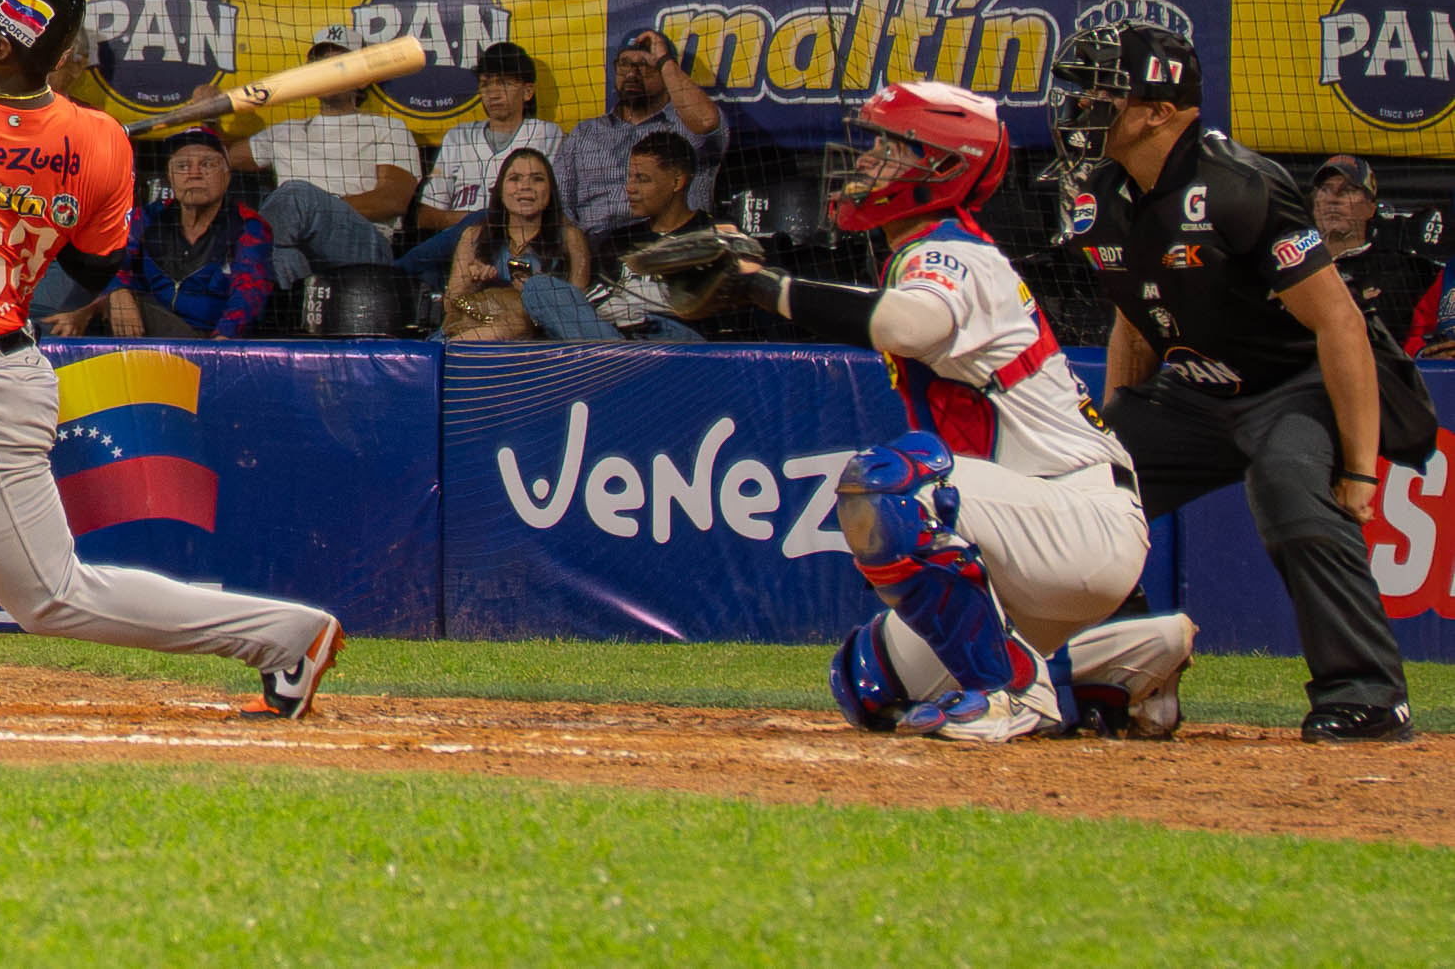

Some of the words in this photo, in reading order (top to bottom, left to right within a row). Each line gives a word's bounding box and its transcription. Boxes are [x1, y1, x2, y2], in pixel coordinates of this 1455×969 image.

[746, 198, 768, 211] TE1
[1183, 186, 1208, 223] G
[1431, 211, 1442, 223] A
[1425, 222, 1443, 234] 03
[1099, 246, 1123, 262] BDT
[306, 286, 330, 300] TE1
[306, 301, 322, 313] 02
[306, 313, 322, 325] 08
[497, 401, 860, 561] Venez
